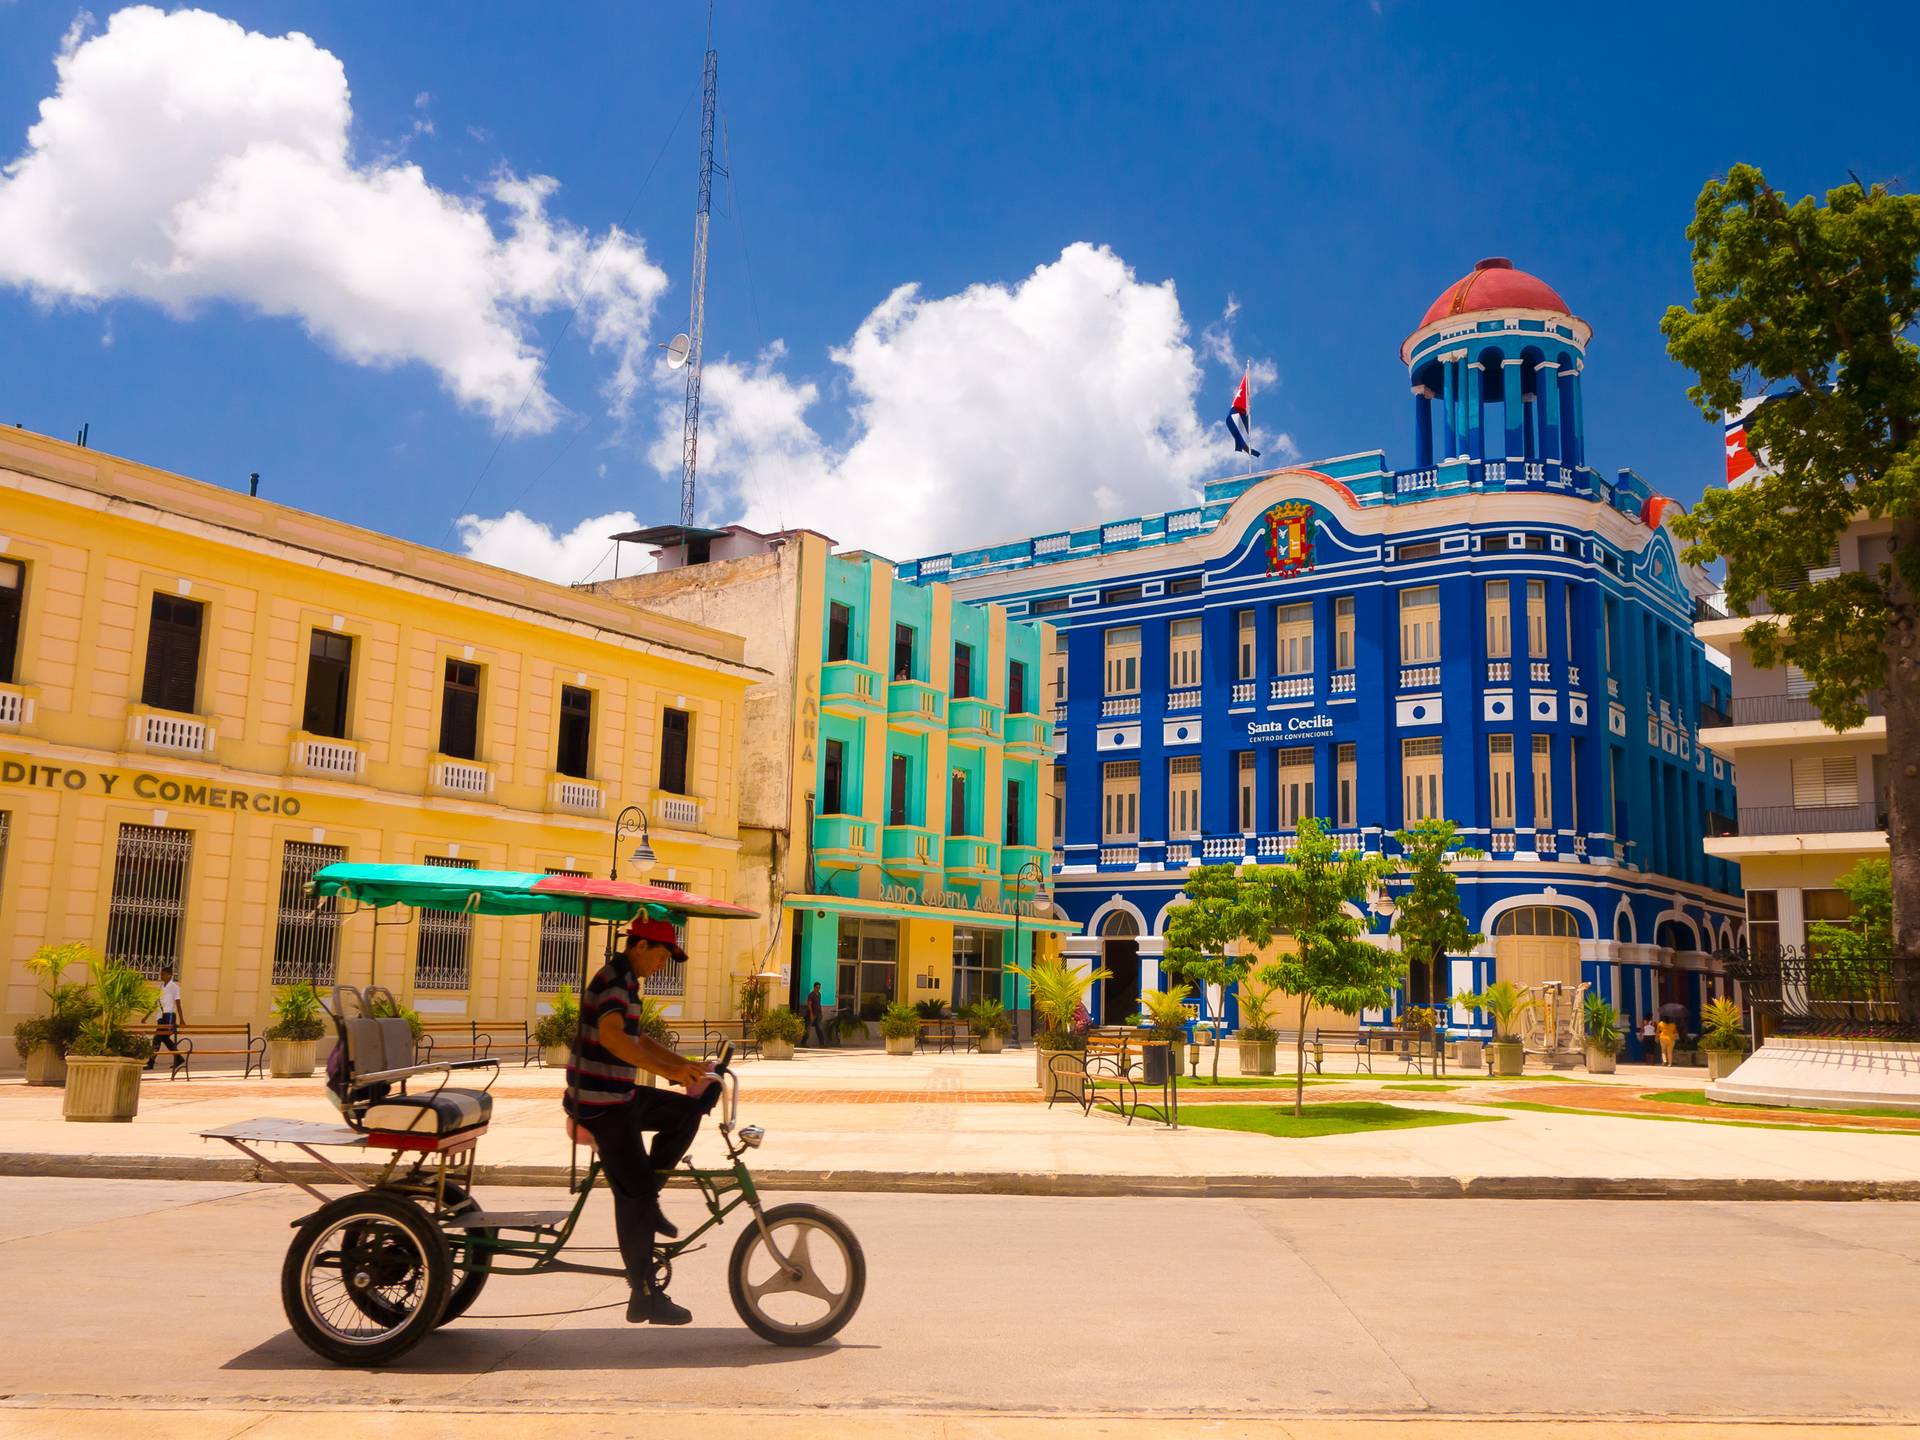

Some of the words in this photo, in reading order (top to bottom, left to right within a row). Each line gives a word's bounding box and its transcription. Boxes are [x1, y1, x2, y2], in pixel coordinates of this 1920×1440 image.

[1247, 721, 1283, 735] Santa
[1288, 714, 1333, 731] Cecilia
[1249, 735, 1275, 743] CENTRO
[1284, 730, 1334, 740] CONVENCIONES
[2, 760, 87, 790] DITO
[99, 773, 120, 794] Y
[133, 773, 301, 816] COMERCIO
[879, 883, 917, 904] RADIO
[921, 888, 969, 910] CADENA
